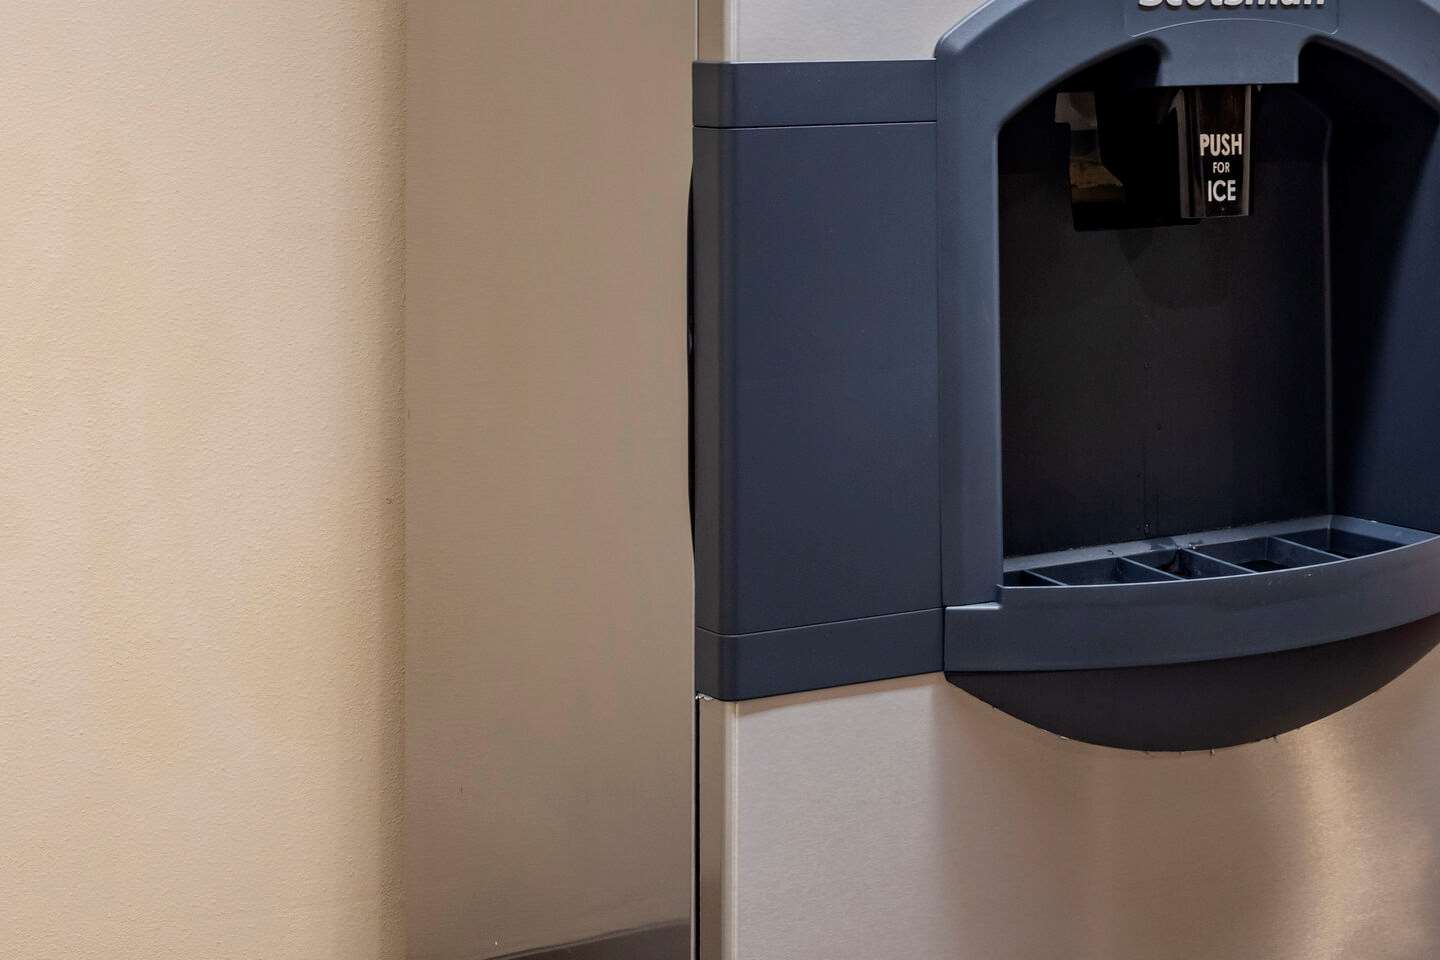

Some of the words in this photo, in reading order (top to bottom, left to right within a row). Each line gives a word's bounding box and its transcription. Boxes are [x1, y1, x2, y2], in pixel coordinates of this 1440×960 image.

[1199, 133, 1243, 156] PUSH
[1212, 161, 1230, 174] FOR
[1207, 179, 1237, 202] ICE
